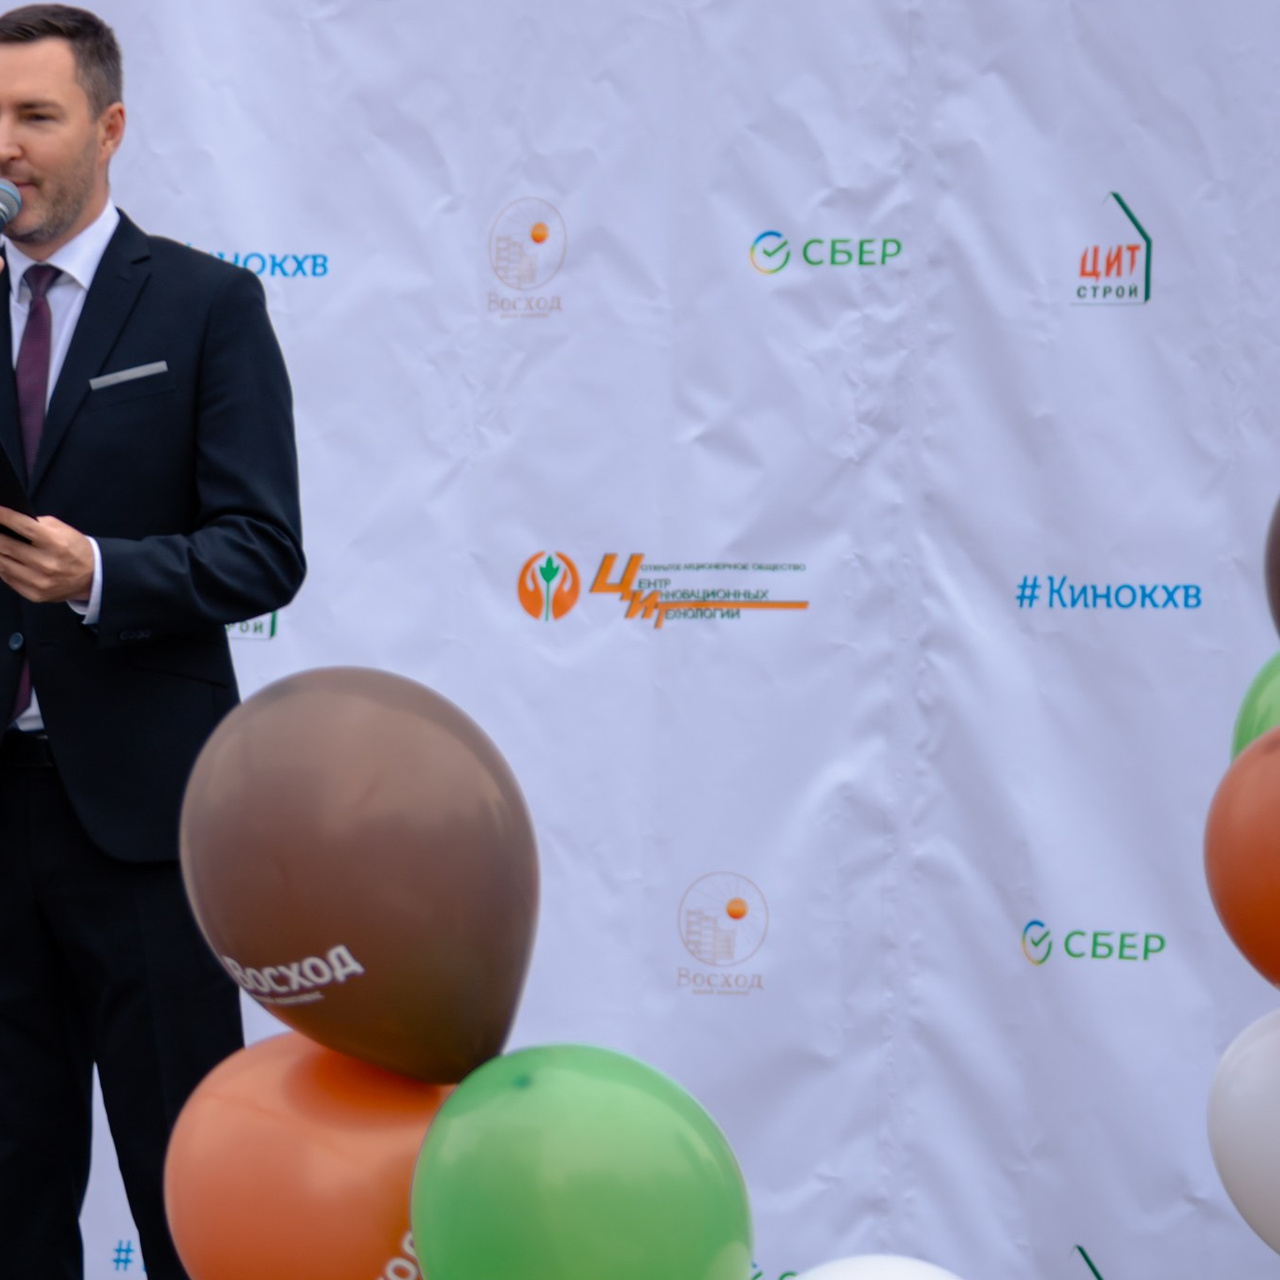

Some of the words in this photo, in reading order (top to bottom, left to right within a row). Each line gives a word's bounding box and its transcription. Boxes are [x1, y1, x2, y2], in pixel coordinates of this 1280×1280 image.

[802, 238, 902, 266] СБЕР
[1078, 244, 1141, 282] ЦИТ
[1076, 282, 1139, 300] СТРОЙ
[1063, 929, 1167, 962] СБЕР
